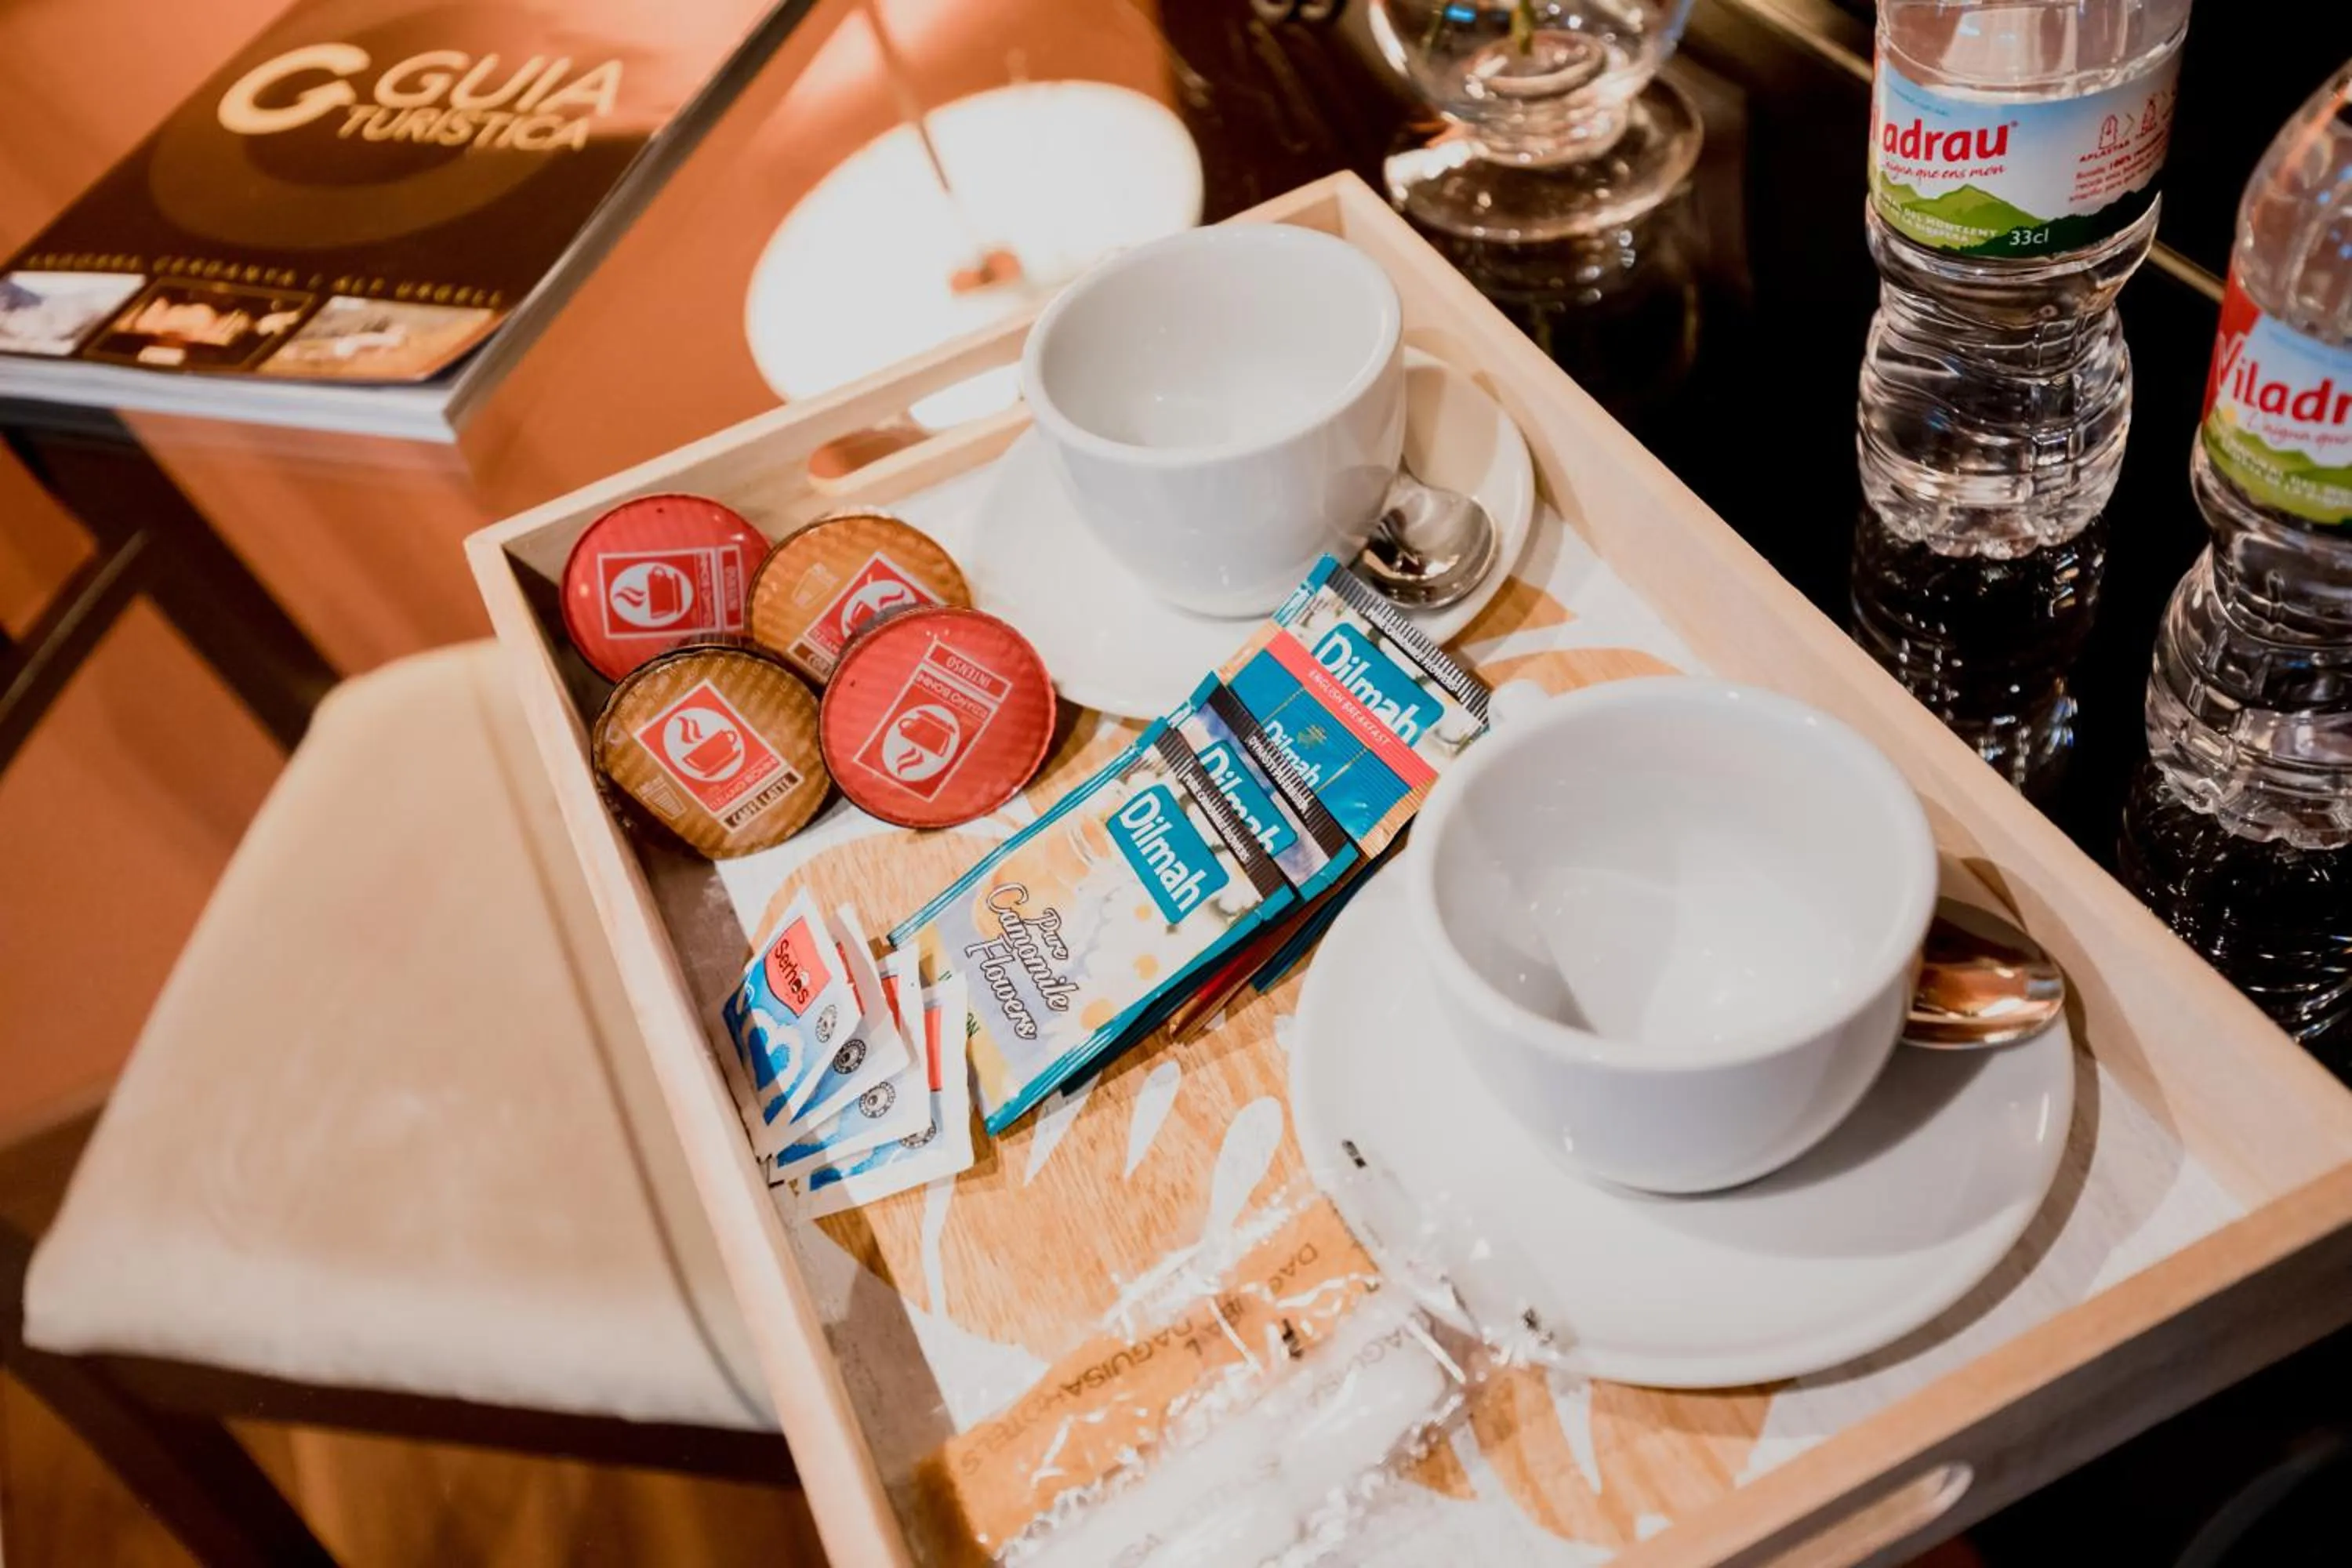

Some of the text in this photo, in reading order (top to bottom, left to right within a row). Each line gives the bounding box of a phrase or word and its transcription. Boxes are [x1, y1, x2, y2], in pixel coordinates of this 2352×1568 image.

[374, 50, 622, 117] GUIA
[2009, 228, 2050, 246] 33cl
[943, 652, 993, 690] INTENSO
[1316, 632, 1421, 746] Dilmah
[1119, 791, 1207, 913] Dilmah
[986, 882, 1080, 1012] Camomile
[1022, 907, 1069, 960] Pure
[775, 938, 810, 1004] Serhos
[964, 933, 1038, 1040] Flowers
